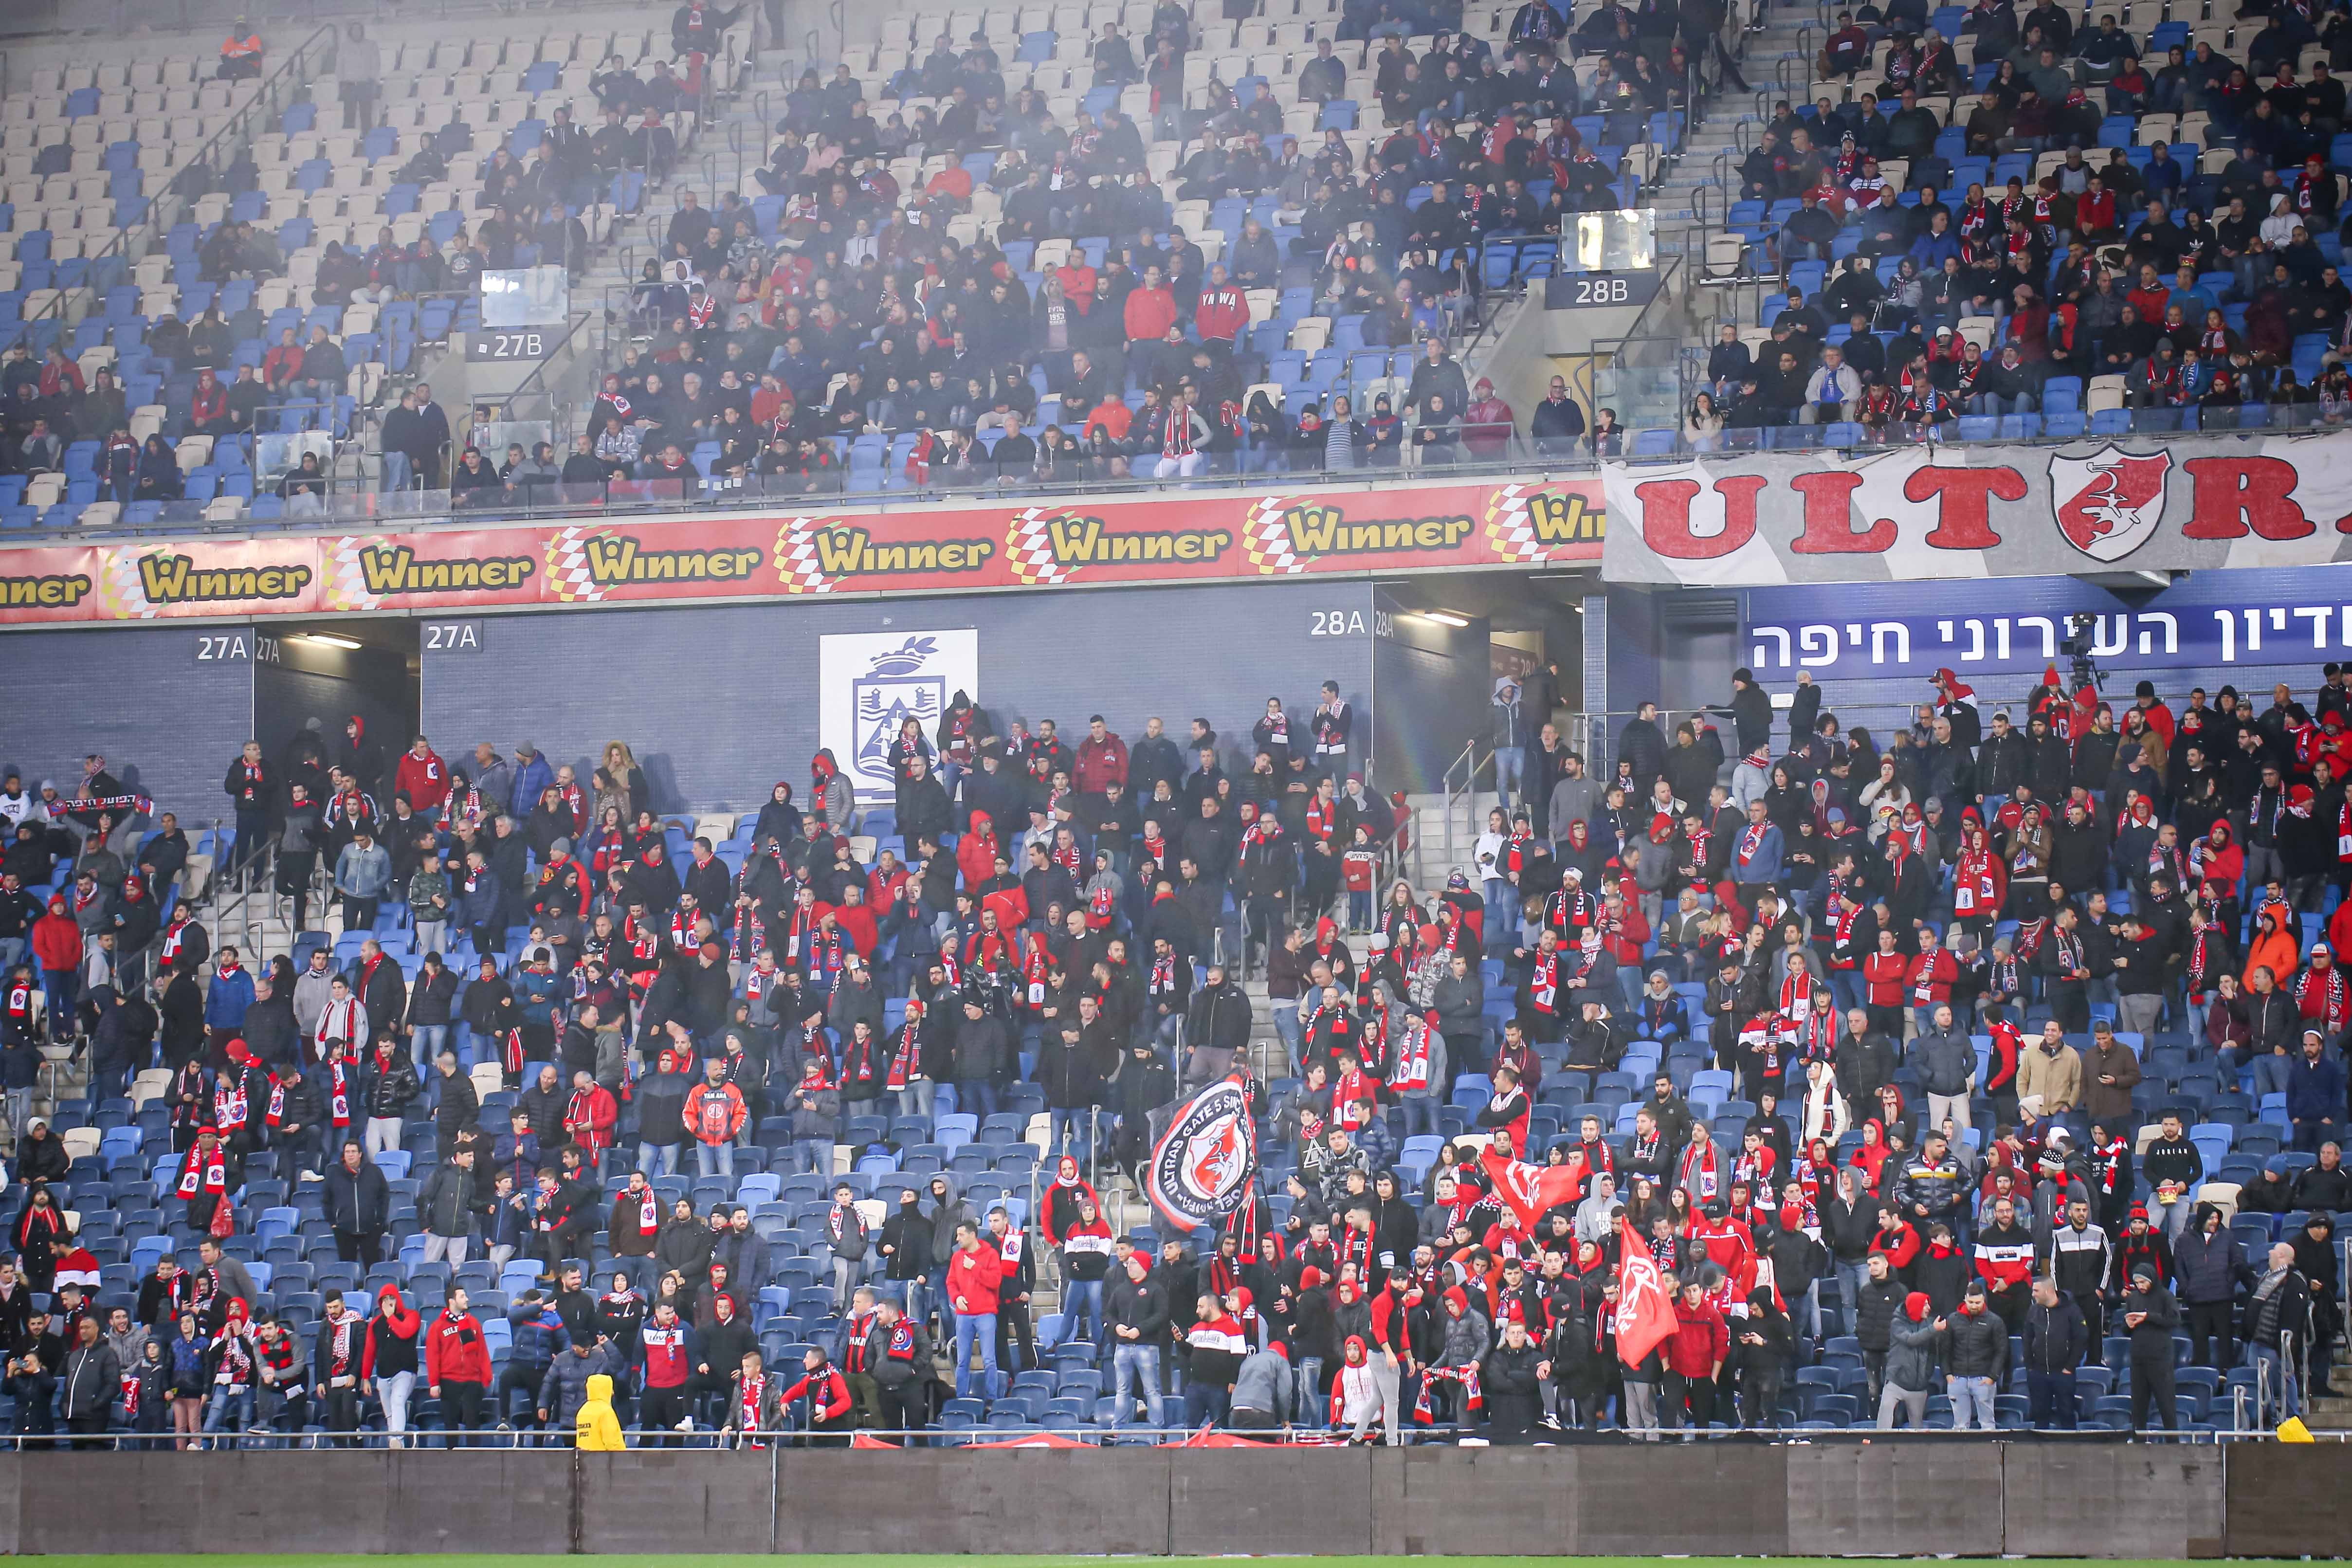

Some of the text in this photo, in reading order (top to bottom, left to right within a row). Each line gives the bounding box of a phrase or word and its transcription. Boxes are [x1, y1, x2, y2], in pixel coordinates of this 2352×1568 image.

[1575, 279, 1628, 304] 28B
[494, 334, 543, 357] 27B
[813, 527, 995, 576] Winner
[1046, 516, 1233, 566] Winner
[1282, 505, 1475, 556] Winner
[138, 554, 312, 604] Winner
[359, 545, 536, 594] Winner
[584, 535, 764, 584] Winner
[426, 624, 477, 650] 27A
[1311, 611, 1366, 637] 28A
[1375, 611, 1393, 638] 28A
[1752, 621, 1910, 668] חיפה
[198, 637, 247, 661] 27A
[256, 637, 280, 664] 27A
[1164, 1139, 1184, 1196] ULTRAS
[1182, 1103, 1214, 1137] GATE
[1214, 1098, 1222, 1112] 5
